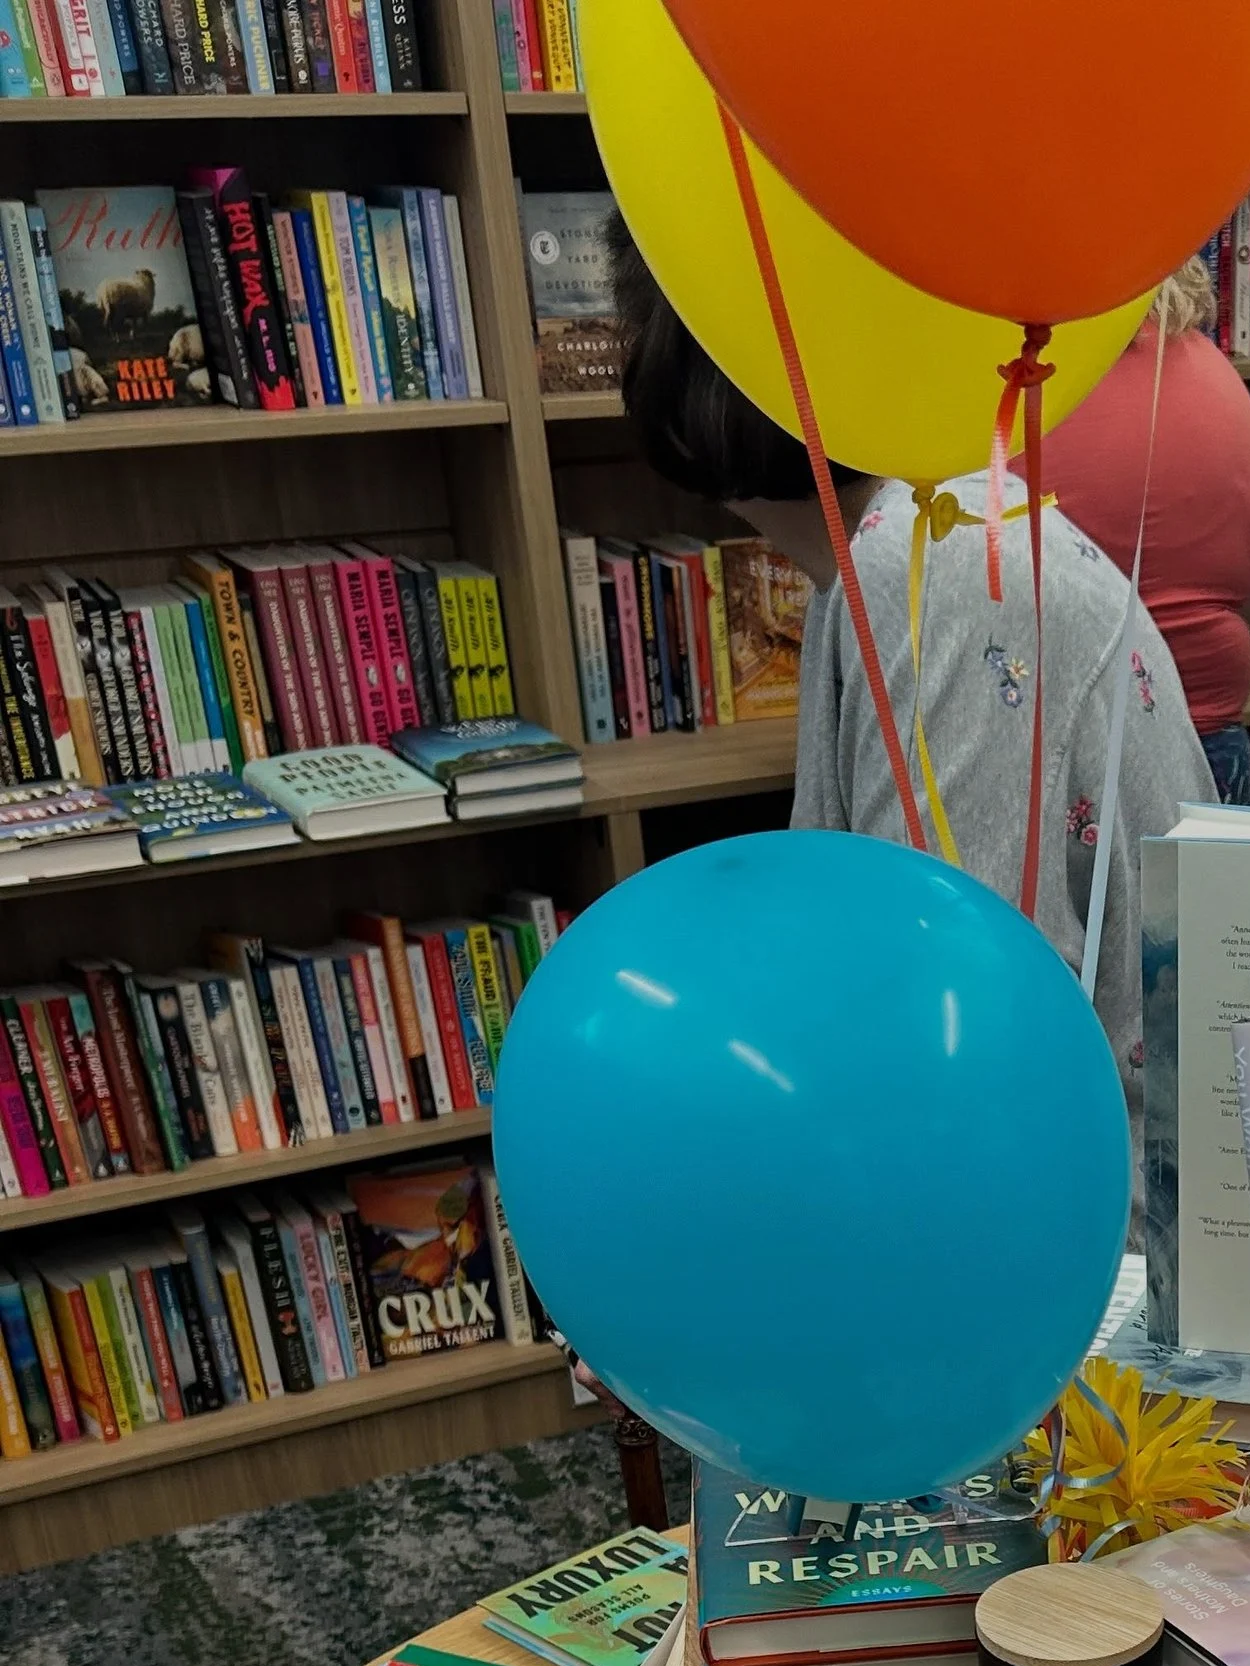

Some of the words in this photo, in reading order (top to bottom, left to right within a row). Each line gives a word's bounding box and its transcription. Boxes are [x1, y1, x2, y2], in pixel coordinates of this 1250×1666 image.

[52, 191, 187, 252] Ruth
[224, 201, 258, 254] HOT
[239, 259, 271, 325] WAX
[116, 379, 177, 401] RILEY
[117, 356, 168, 380] KATE
[346, 571, 365, 611] MARIA
[376, 567, 395, 609] MARIA
[216, 580, 236, 625] TOWN
[231, 646, 256, 718] COUNTRY
[355, 614, 374, 662] SEMPLE
[385, 612, 403, 659] SEMPLE
[378, 1278, 496, 1339] CRUX
[506, 1535, 671, 1619] LUXURY
[747, 1541, 1004, 1586] RESPAIR
[850, 1584, 914, 1599] ESSAYS
